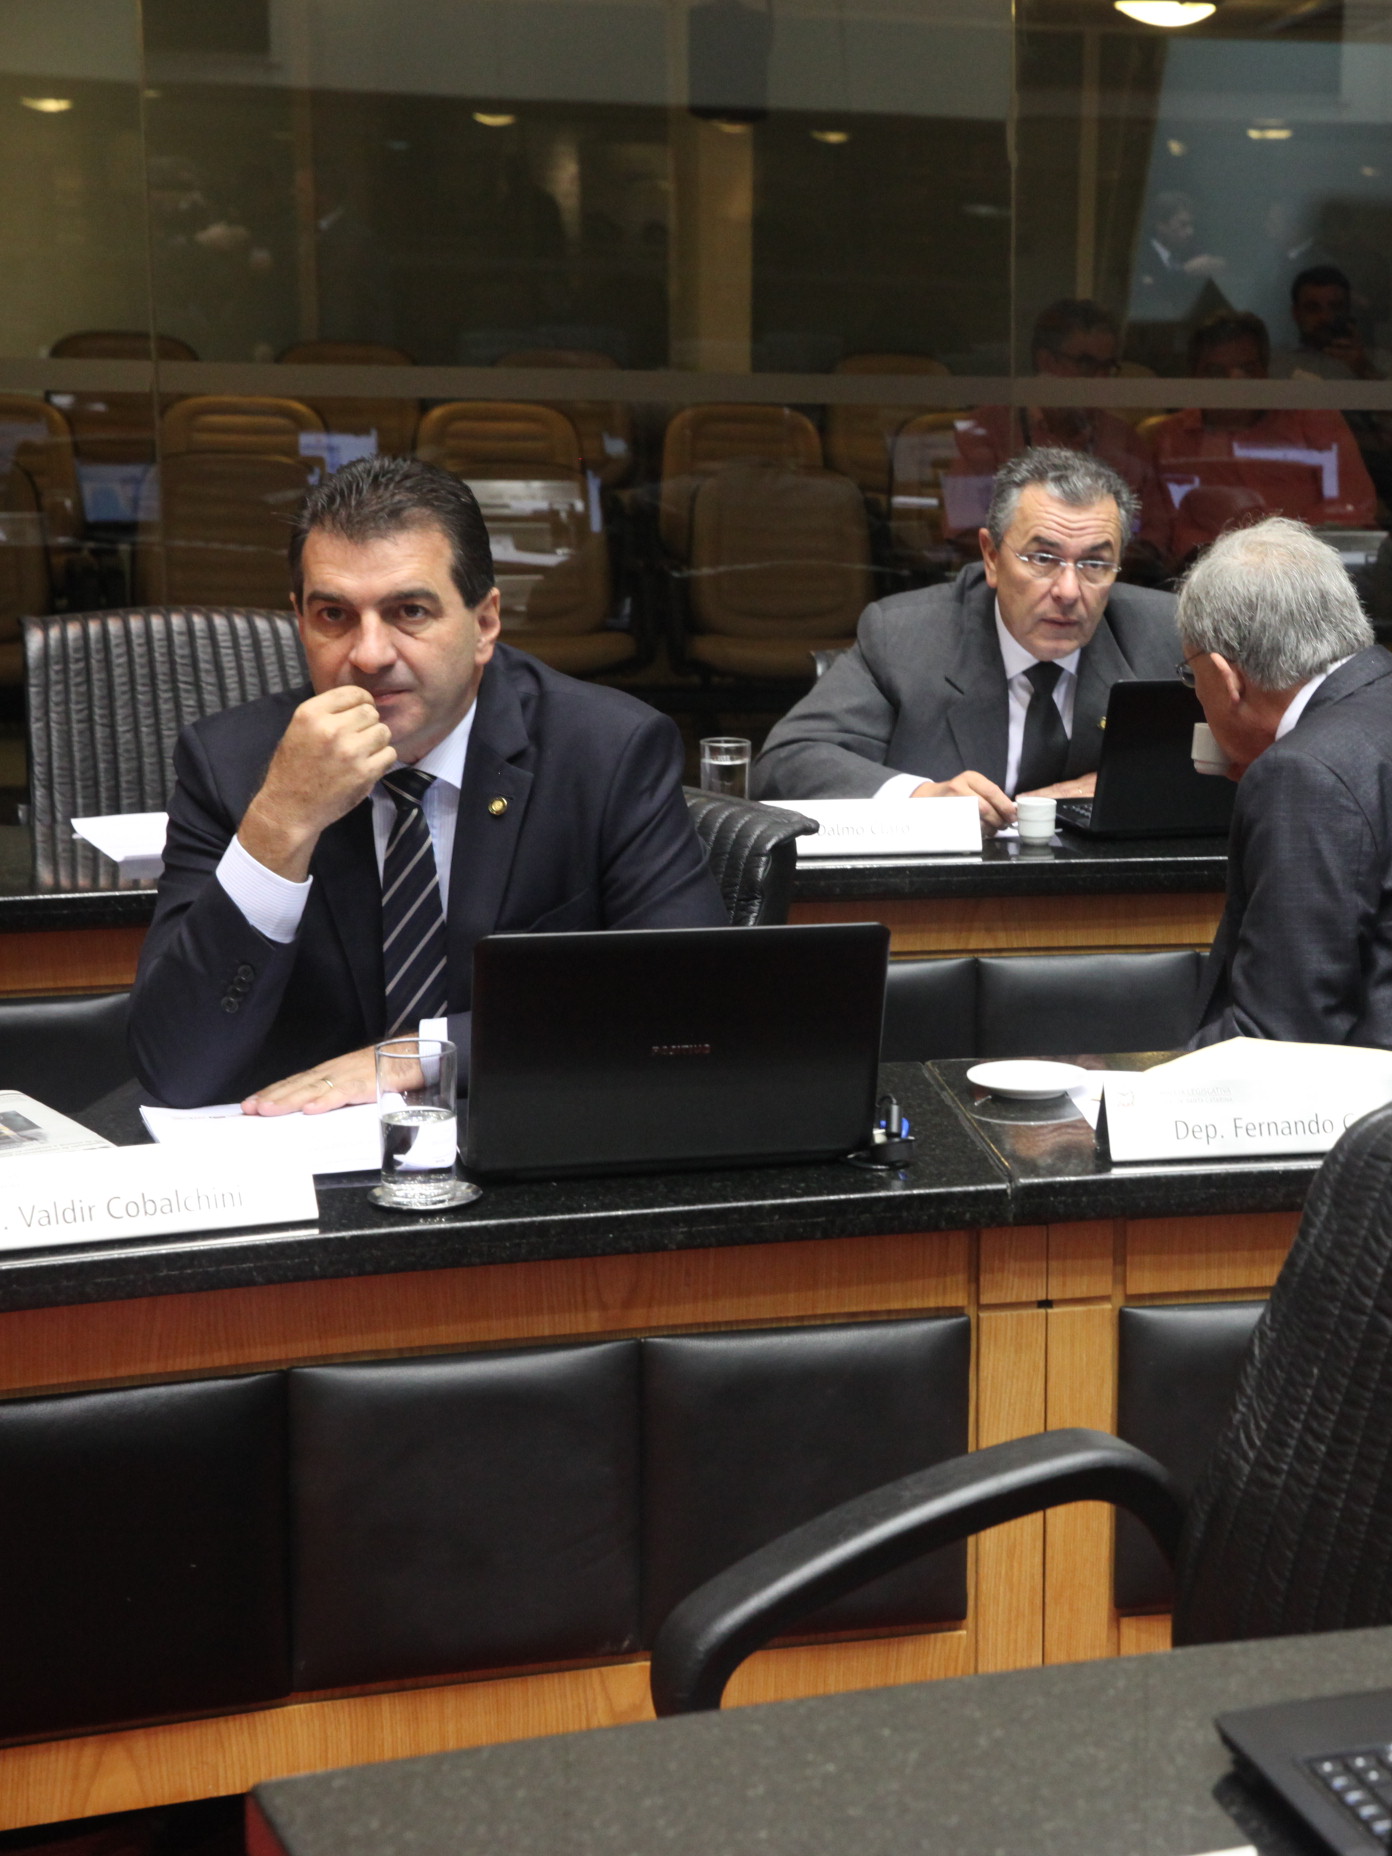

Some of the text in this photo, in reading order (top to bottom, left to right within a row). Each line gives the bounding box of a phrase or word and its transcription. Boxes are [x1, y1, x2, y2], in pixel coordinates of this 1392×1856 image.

[1174, 1119, 1224, 1146] Dep.
[1232, 1112, 1335, 1140] Fernando
[18, 1184, 244, 1229] Valdir Cobalchini
